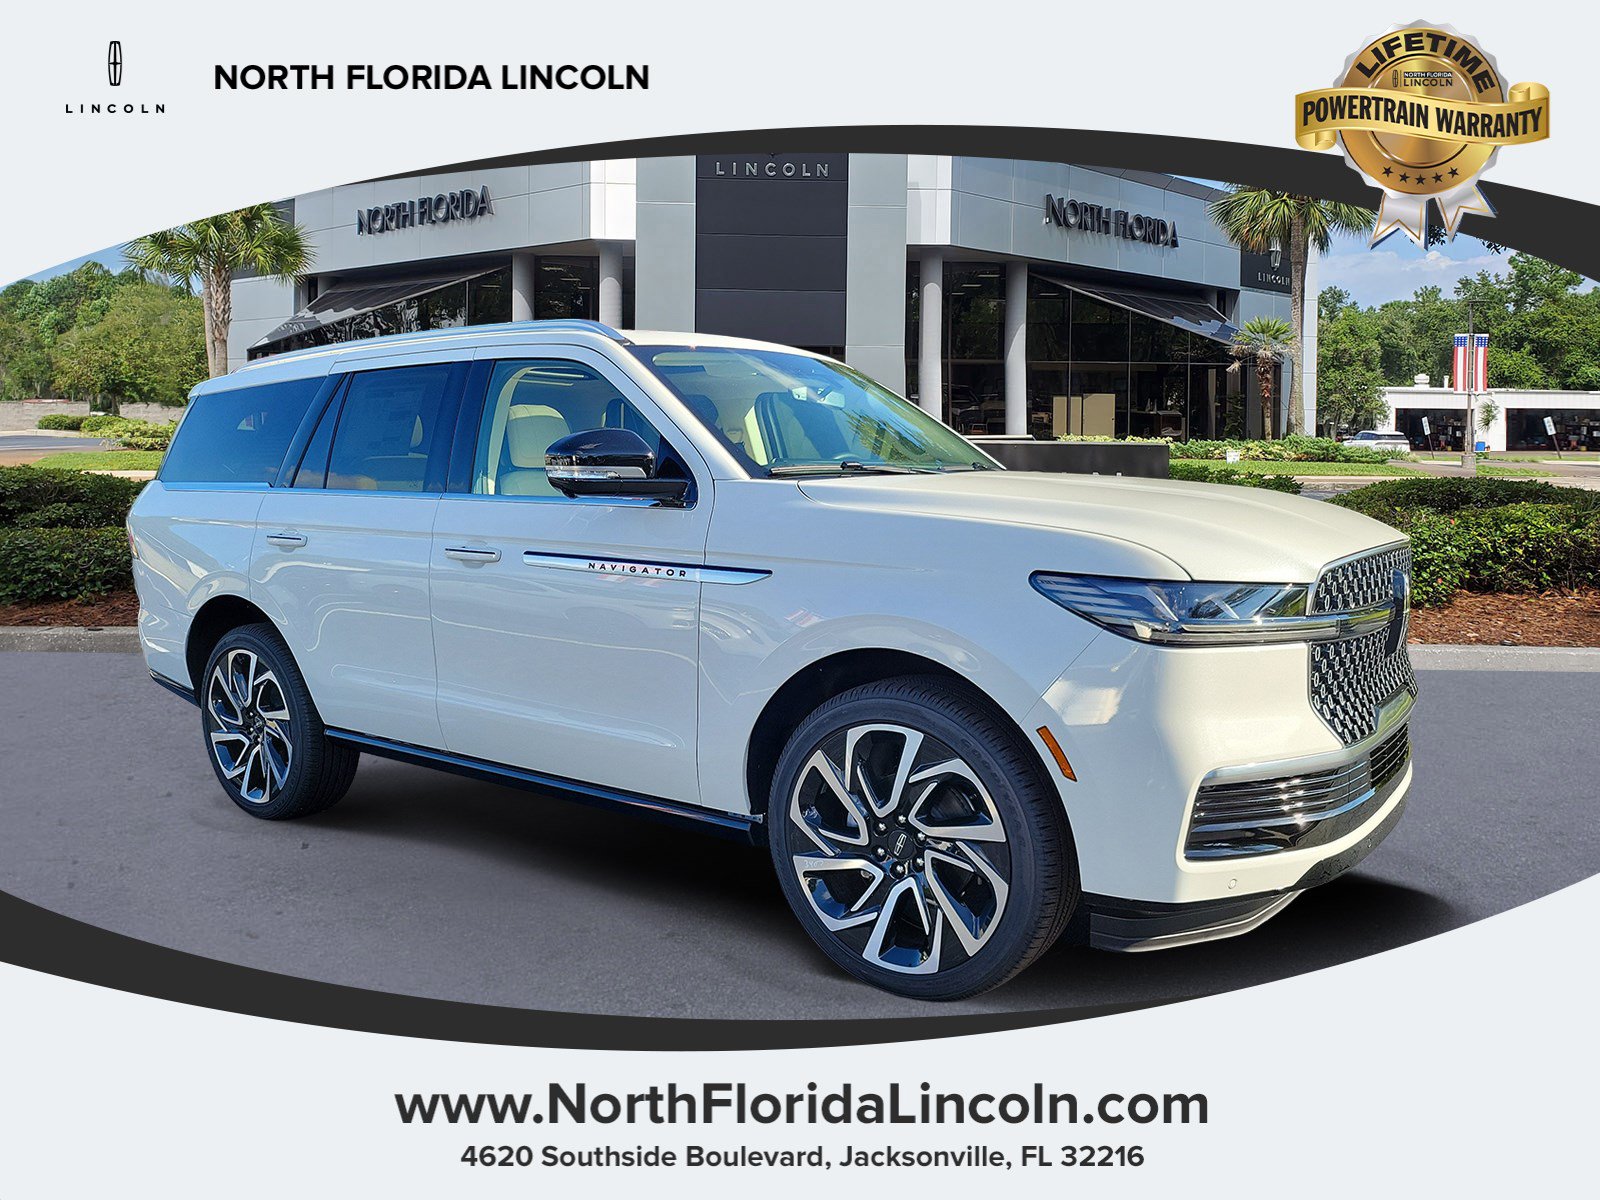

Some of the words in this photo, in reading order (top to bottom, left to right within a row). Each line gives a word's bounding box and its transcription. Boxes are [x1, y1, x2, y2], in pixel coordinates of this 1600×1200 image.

[714, 161, 830, 178] LINCOLN
[357, 200, 415, 236] NORTH
[417, 185, 495, 225] FLORIDA
[1045, 193, 1112, 236] NORTH
[1114, 210, 1180, 249] FLORIDA
[588, 562, 687, 578] NAVIGATOR
